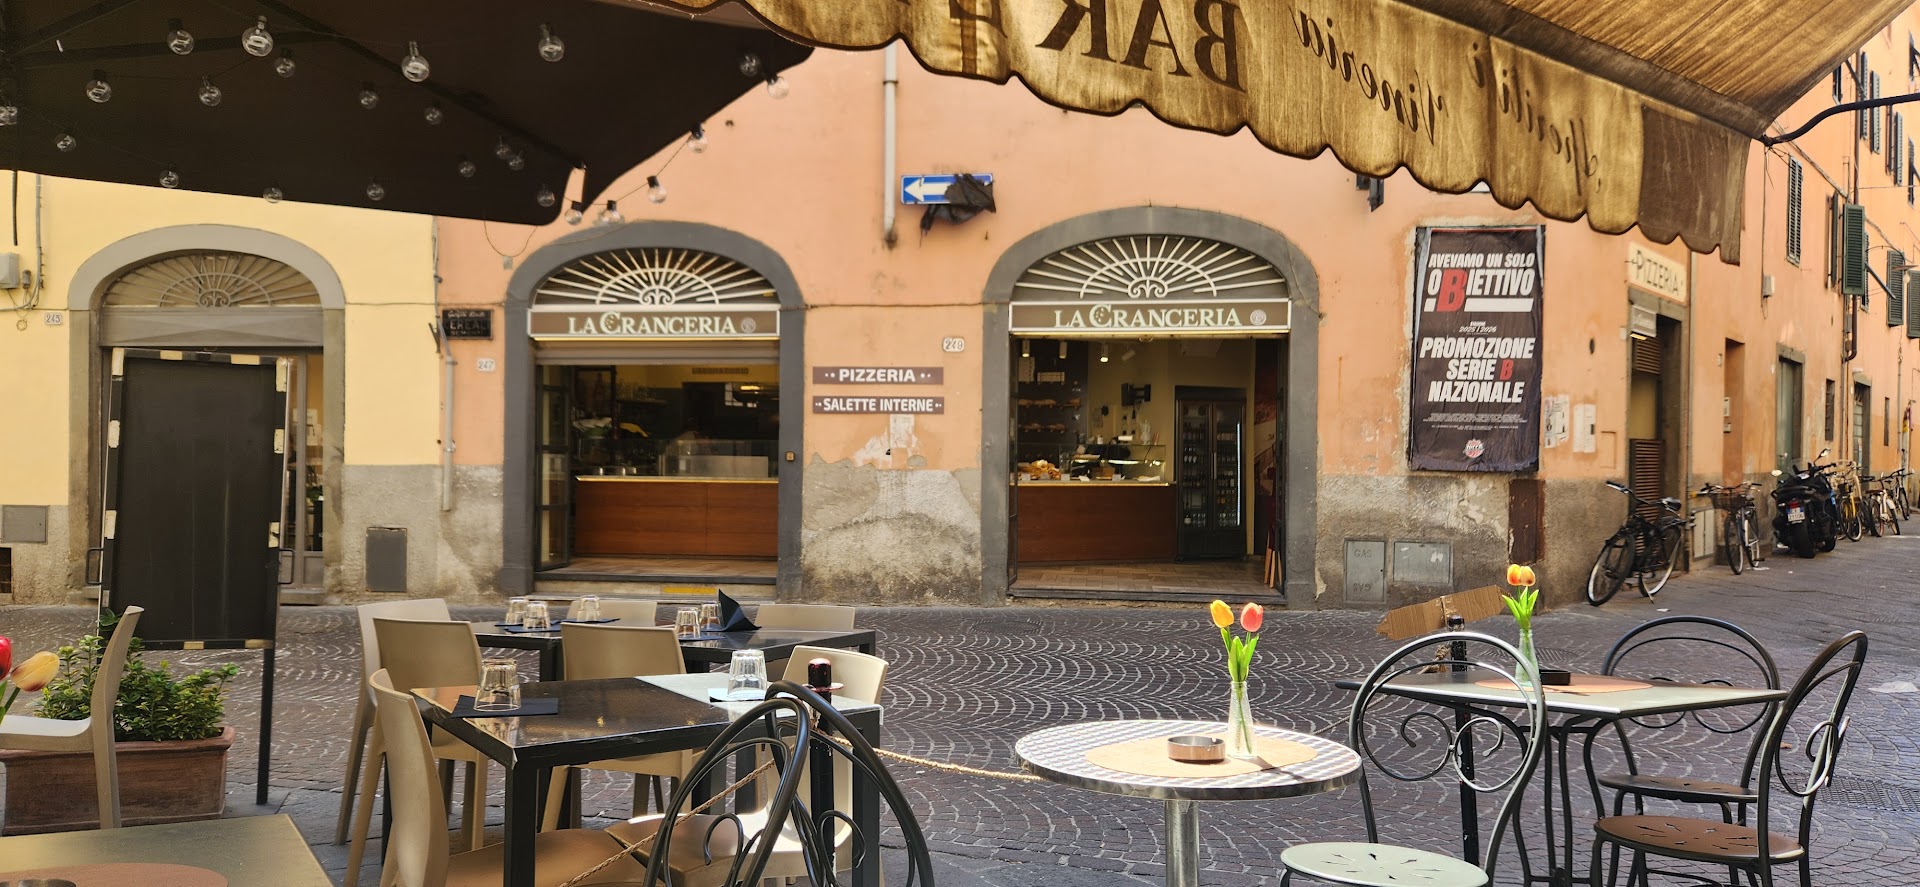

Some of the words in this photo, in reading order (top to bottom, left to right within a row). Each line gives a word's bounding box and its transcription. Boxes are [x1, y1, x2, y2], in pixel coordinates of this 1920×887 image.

[1428, 253, 1484, 268] AVEVAMO
[1486, 253, 1503, 268] UN
[1504, 252, 1536, 268] SOLO
[1635, 249, 1681, 297] PIZZERIA
[1427, 268, 1536, 312] OBIETTIVO
[568, 316, 598, 334] LA
[1054, 310, 1087, 328] LA
[945, 340, 963, 350] 249
[1420, 337, 1536, 358] PROMOZIONE
[839, 368, 916, 382] PIZZERIA
[1446, 358, 1497, 380] SERIE
[1500, 359, 1514, 380] B
[1428, 381, 1525, 403] NAZIONALE
[823, 398, 877, 411] SALETTE
[880, 399, 934, 412] INTERNE
[1353, 549, 1372, 558] GAS
